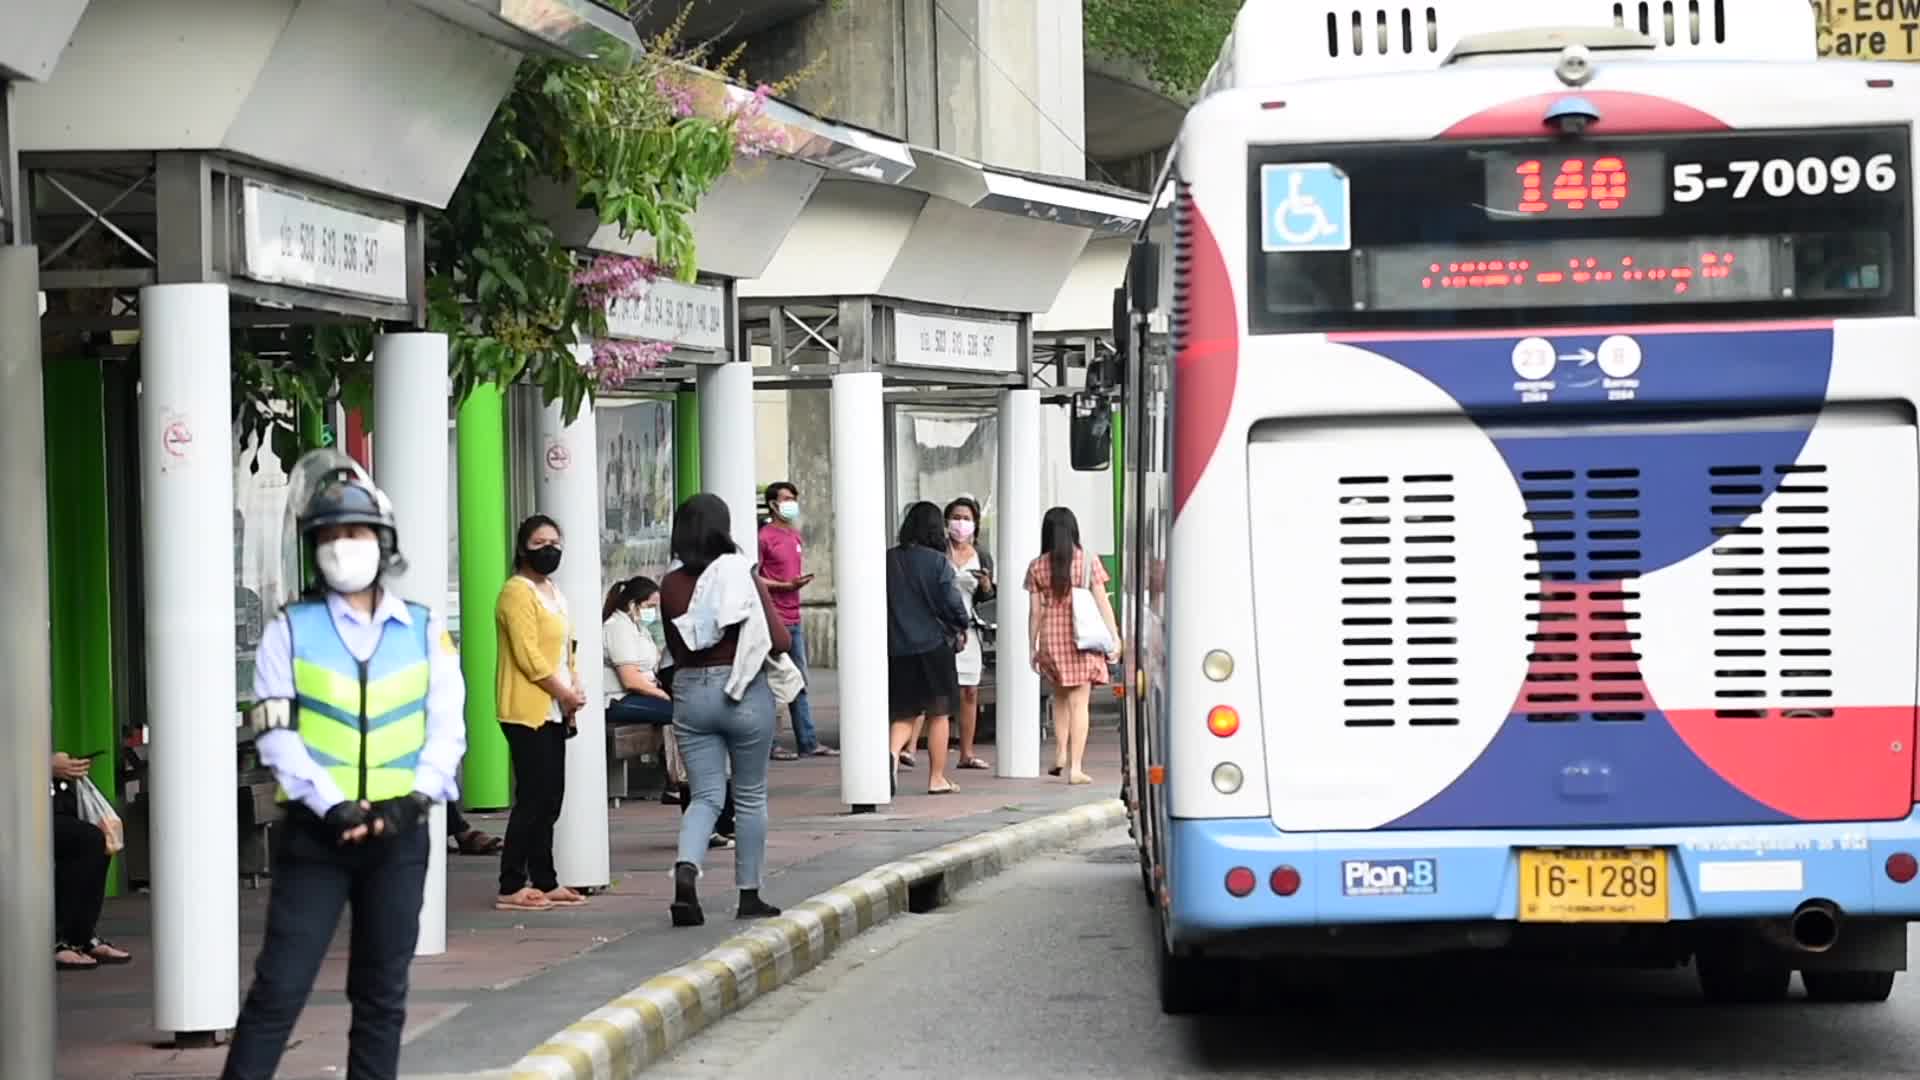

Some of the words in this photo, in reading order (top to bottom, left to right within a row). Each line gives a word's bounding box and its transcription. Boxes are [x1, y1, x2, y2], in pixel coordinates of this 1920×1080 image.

[1816, 26, 1886, 56] Care
[1516, 157, 1627, 211] 140
[1672, 153, 1897, 202] 5-70096
[1534, 865, 1657, 897] 16-1289
